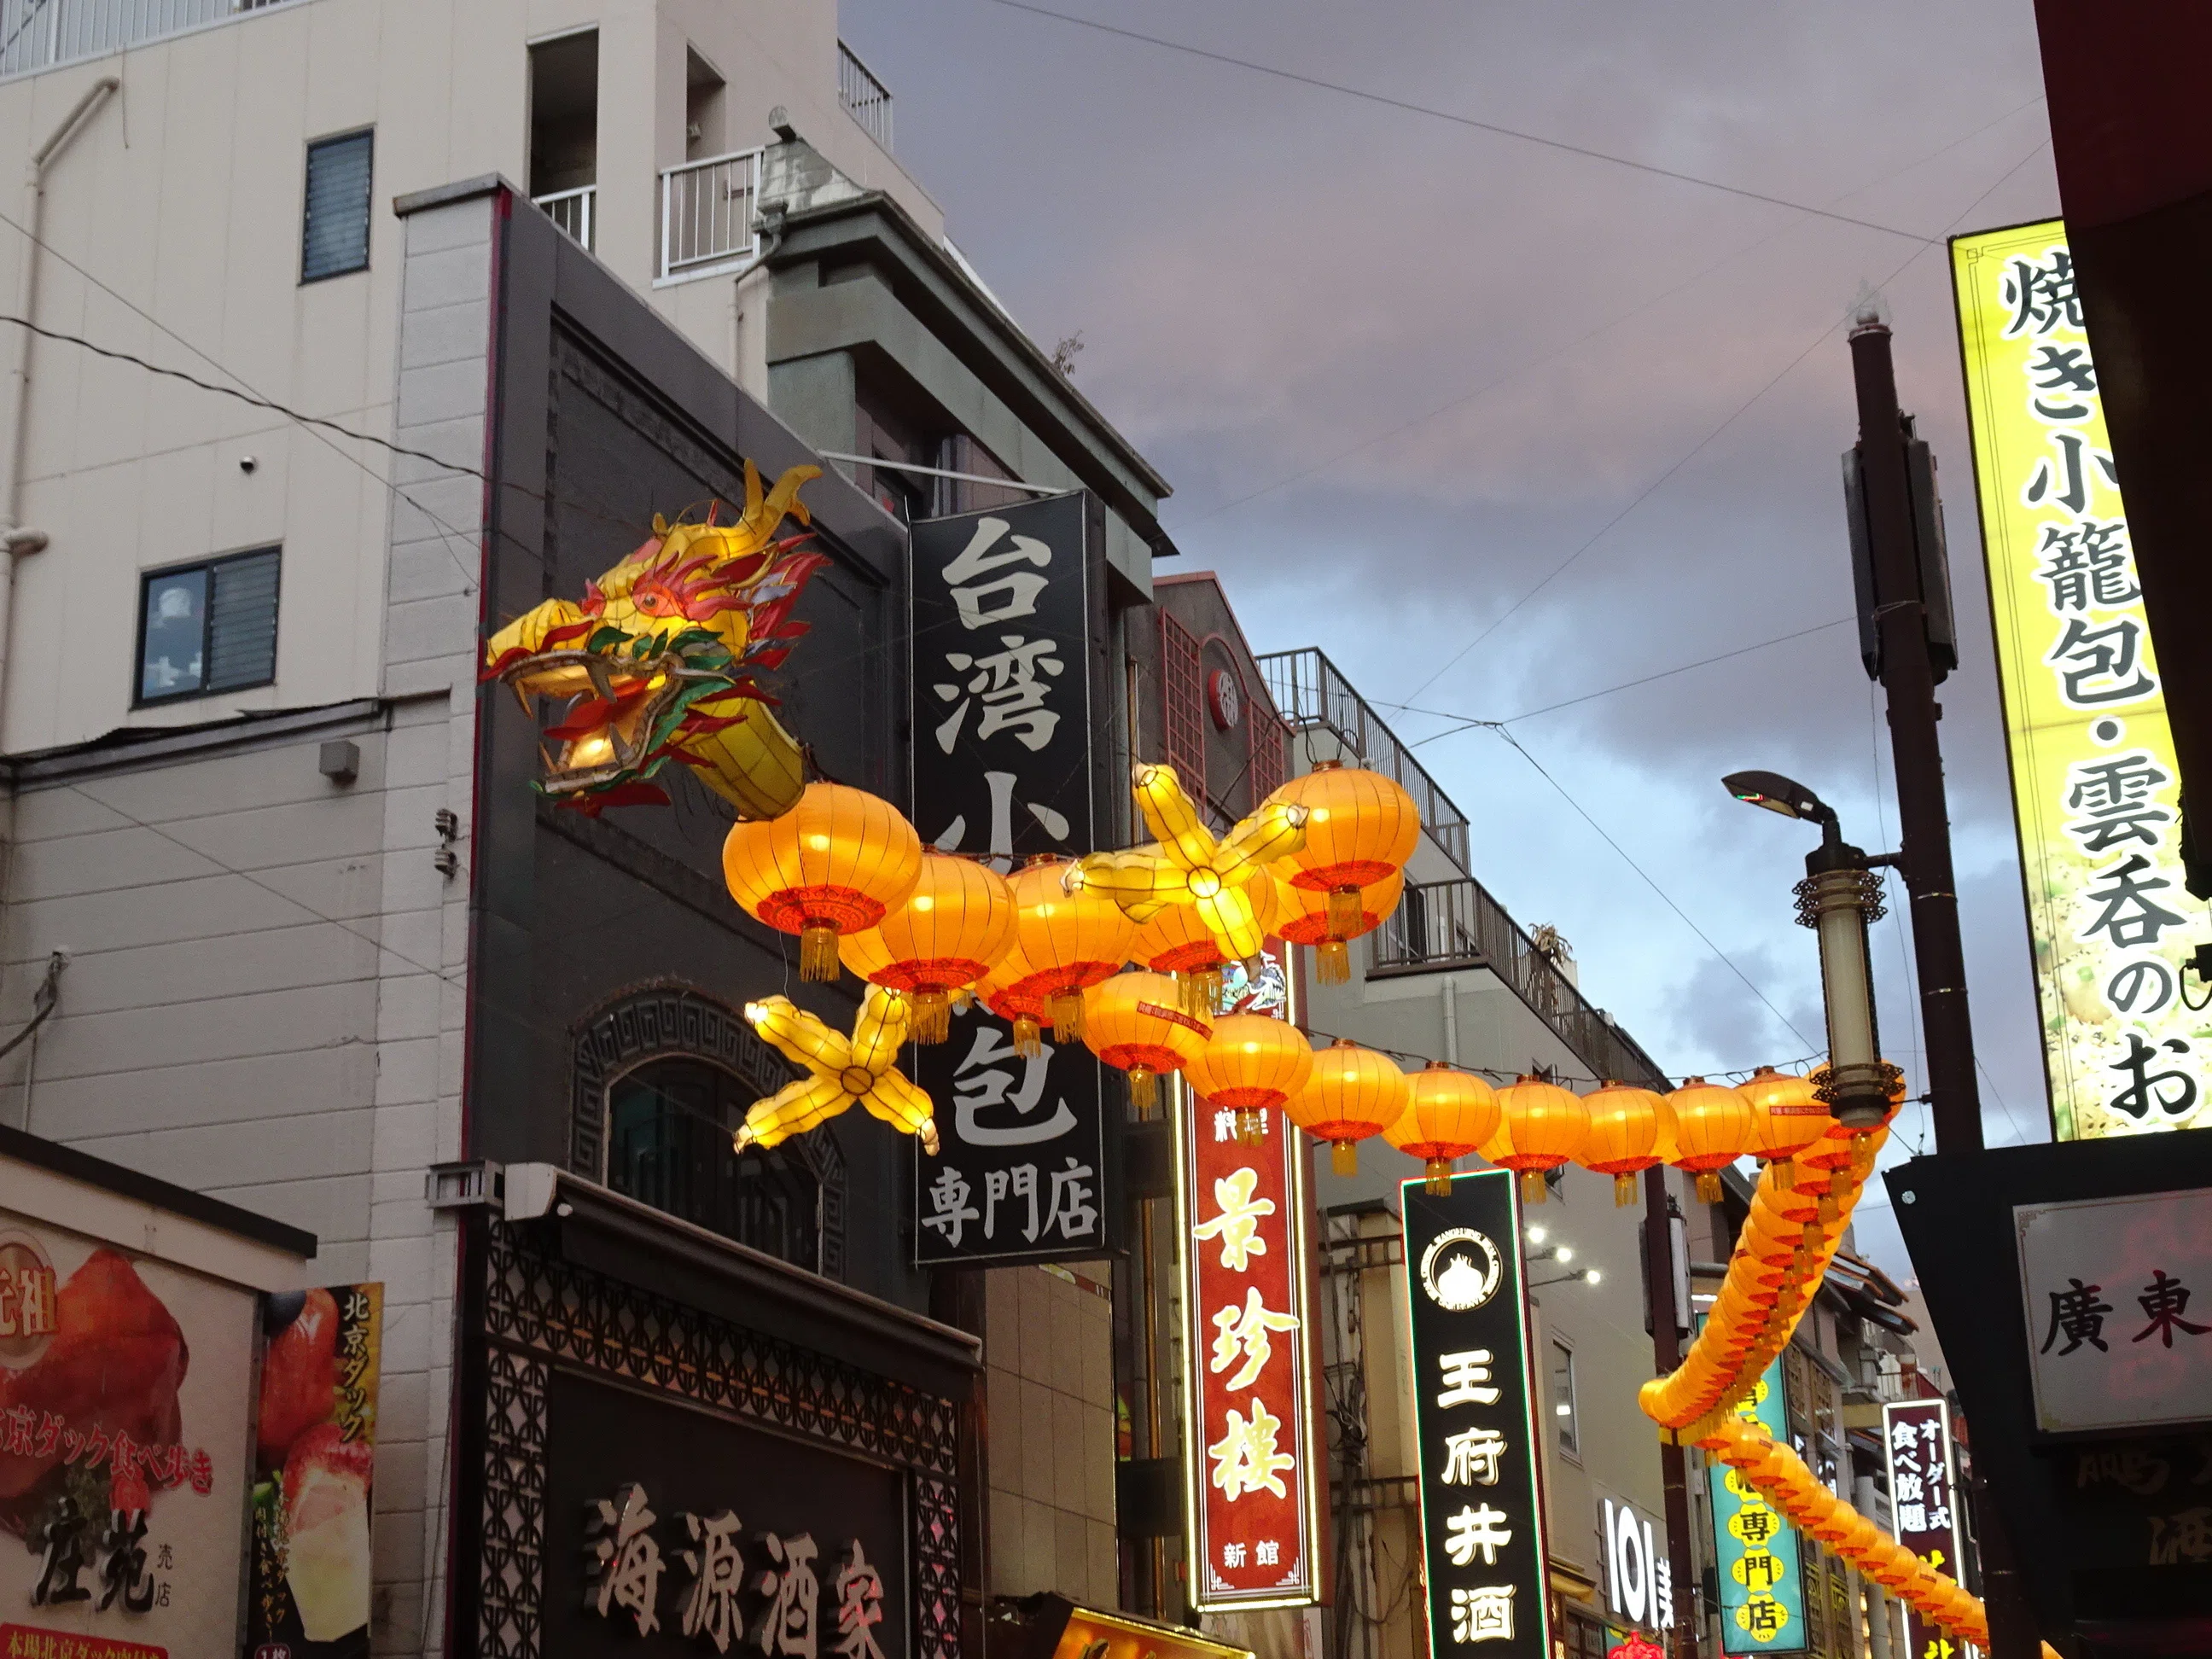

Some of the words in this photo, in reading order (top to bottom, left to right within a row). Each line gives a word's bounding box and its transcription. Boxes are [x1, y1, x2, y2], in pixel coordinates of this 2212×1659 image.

[934, 516, 1078, 1147] 台湾小包
[921, 1156, 1098, 1249] 専門店
[341, 1292, 370, 1443] 北京ダック
[2040, 1270, 2212, 1356] 廣東
[0, 1403, 212, 1496] 京ダック食べ歩き
[1438, 1349, 1516, 1644] 王府井酒
[1891, 1421, 1927, 1532] 食べ放題
[1920, 1418, 1951, 1529] オーダー式
[155, 1544, 173, 1607] 売店
[596, 1482, 886, 1659] 海源酒家
[1223, 1540, 1280, 1569] 新館
